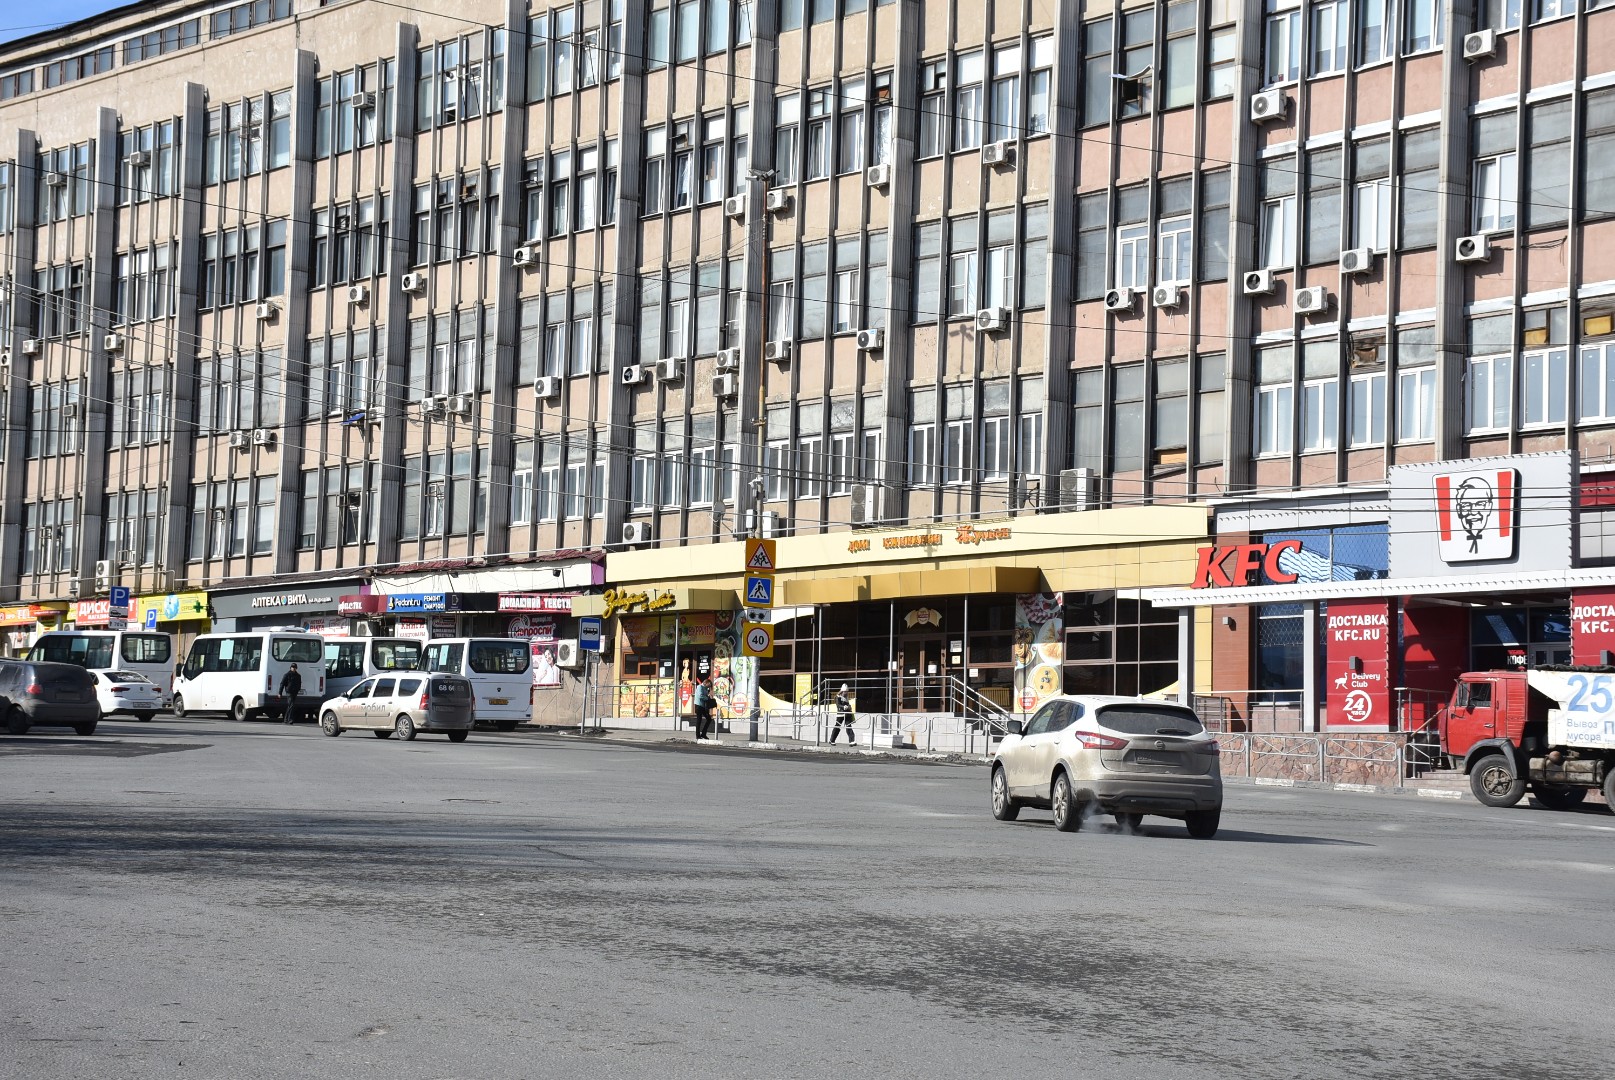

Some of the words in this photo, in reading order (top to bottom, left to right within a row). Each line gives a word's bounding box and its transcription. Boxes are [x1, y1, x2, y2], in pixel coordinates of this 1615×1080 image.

[1190, 540, 1303, 589] KFC
[252, 595, 281, 607] АПТЕКА
[287, 594, 308, 605] ВИТА
[1328, 614, 1387, 628] ДОСТАВКА
[751, 635, 764, 645] 40
[1335, 629, 1380, 641] KFC.RU
[1507, 655, 1528, 665] КОФЕ
[1351, 673, 1380, 682] Delivery
[1343, 697, 1364, 711] 24
[1567, 719, 1598, 728] Вывоз
[1567, 733, 1602, 743] мусора
